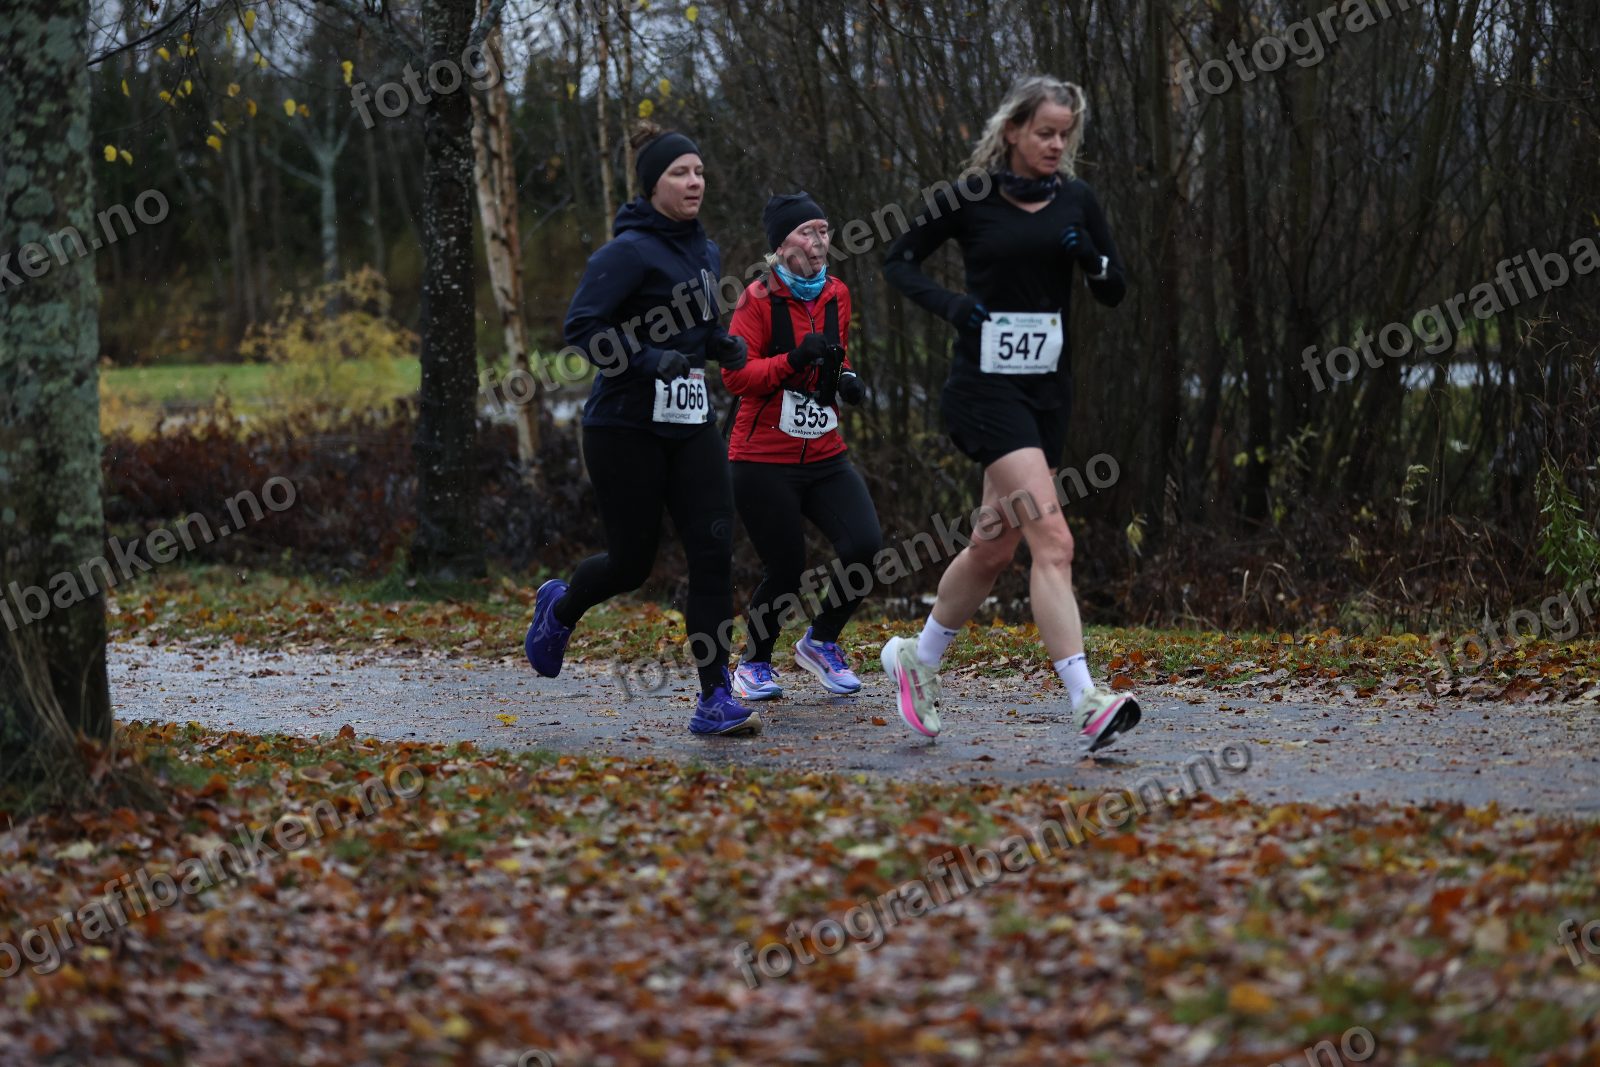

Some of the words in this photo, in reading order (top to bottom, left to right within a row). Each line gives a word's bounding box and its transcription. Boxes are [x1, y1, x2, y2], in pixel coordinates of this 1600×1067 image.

[998, 332, 1048, 361] 547
[663, 383, 704, 410] 1066
[793, 403, 829, 429] 555
